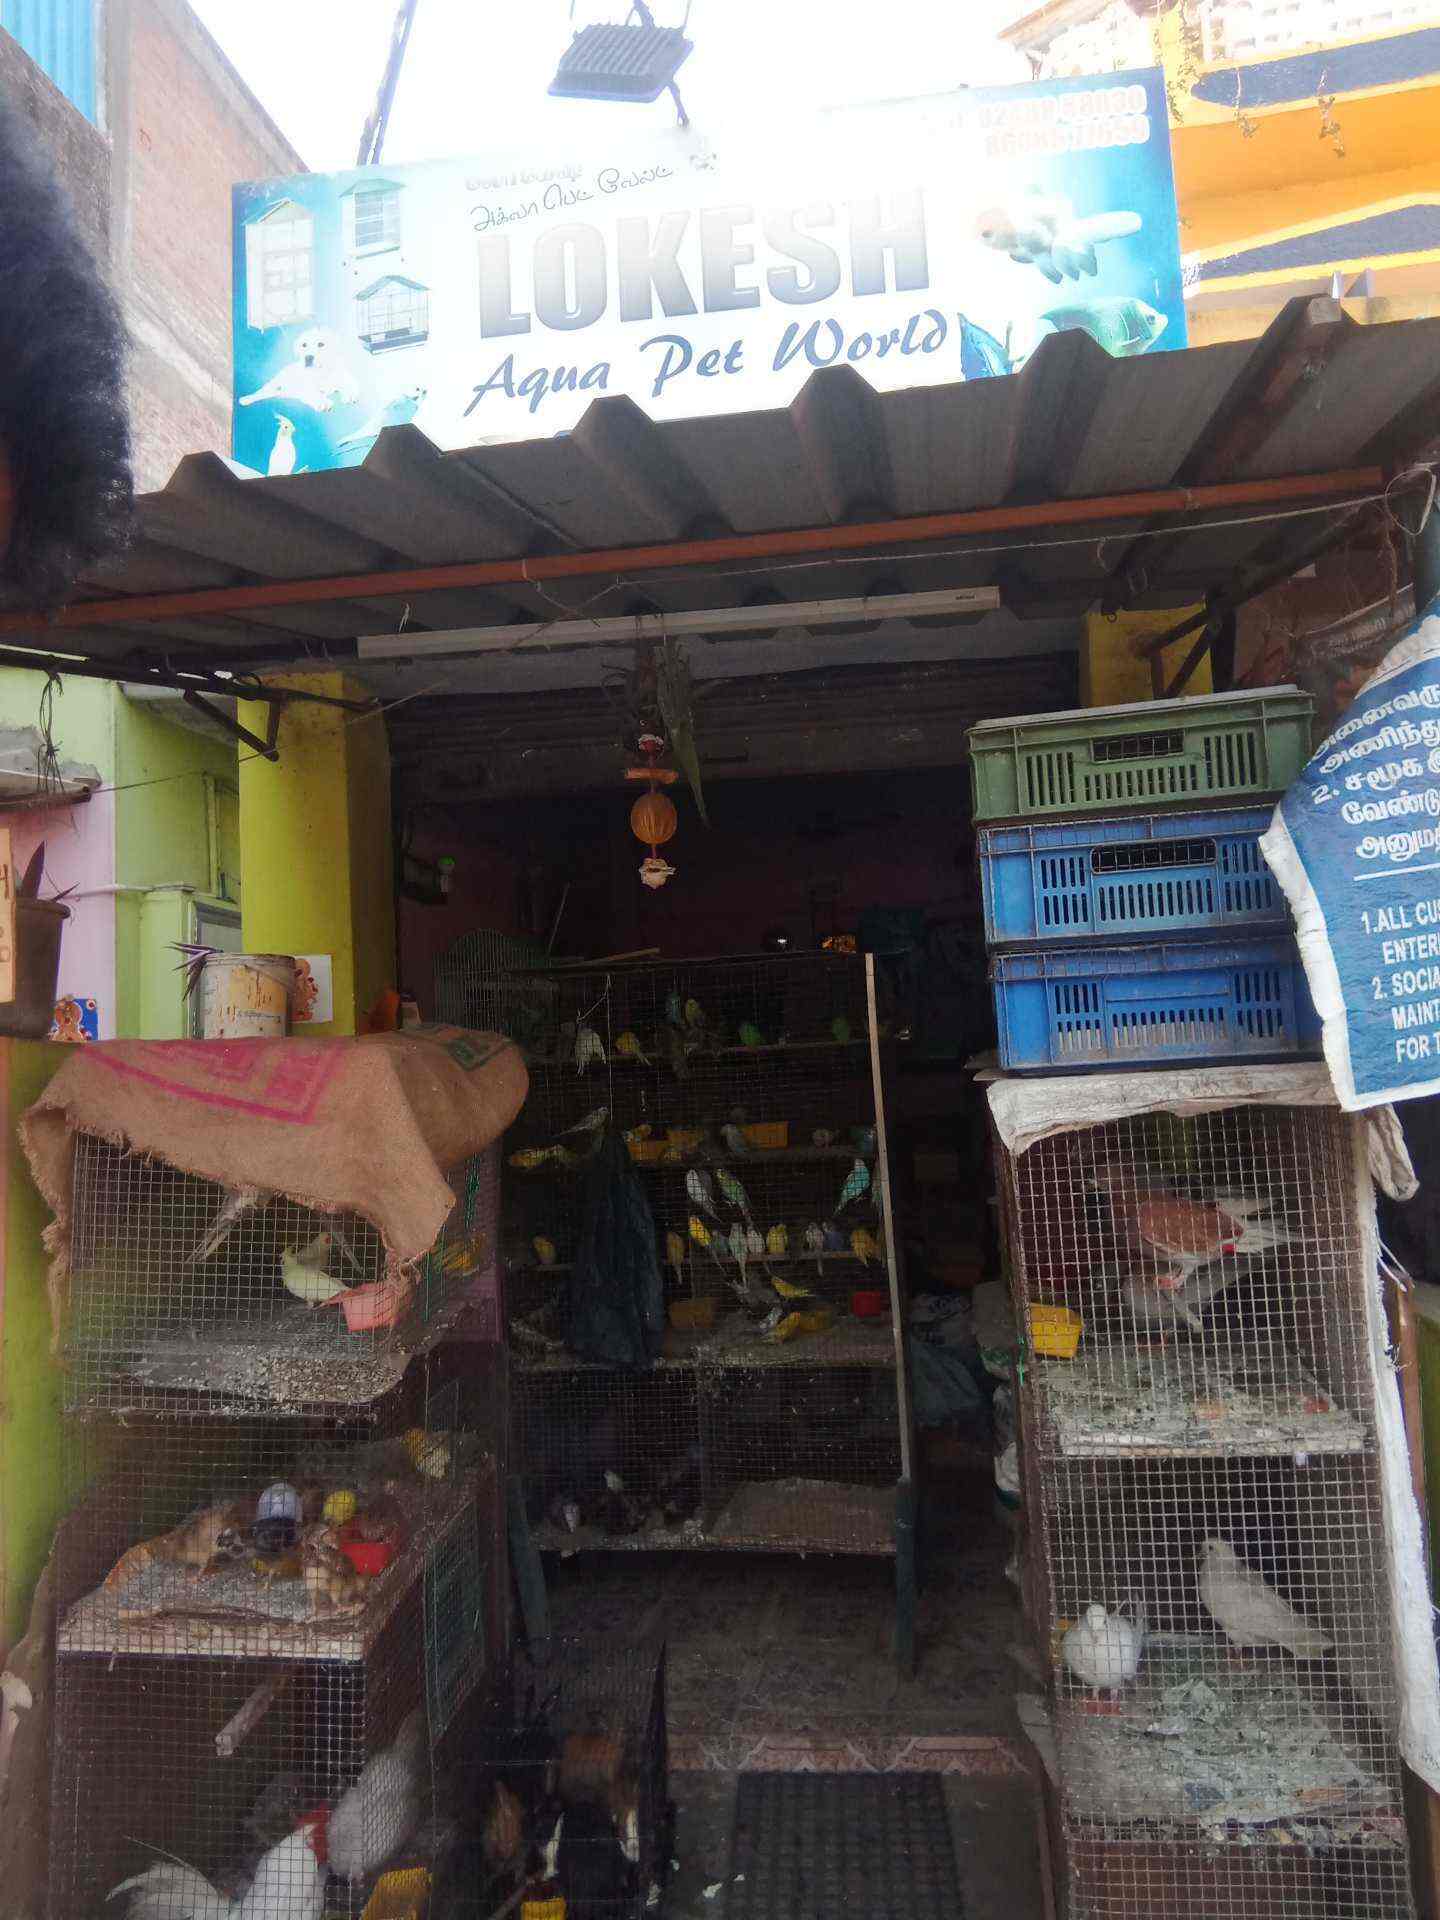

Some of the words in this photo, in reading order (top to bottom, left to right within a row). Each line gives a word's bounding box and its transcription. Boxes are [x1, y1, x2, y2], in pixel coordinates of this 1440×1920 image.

[477, 192, 929, 339] LOKESH
[463, 353, 611, 418] Aqua
[639, 334, 744, 398] Pet
[772, 308, 948, 368] World
[1312, 784, 1340, 805] 2.
[1382, 931, 1440, 965] ENTER
[1371, 975, 1389, 1001] 2.
[1395, 1033, 1431, 1064] FOR
